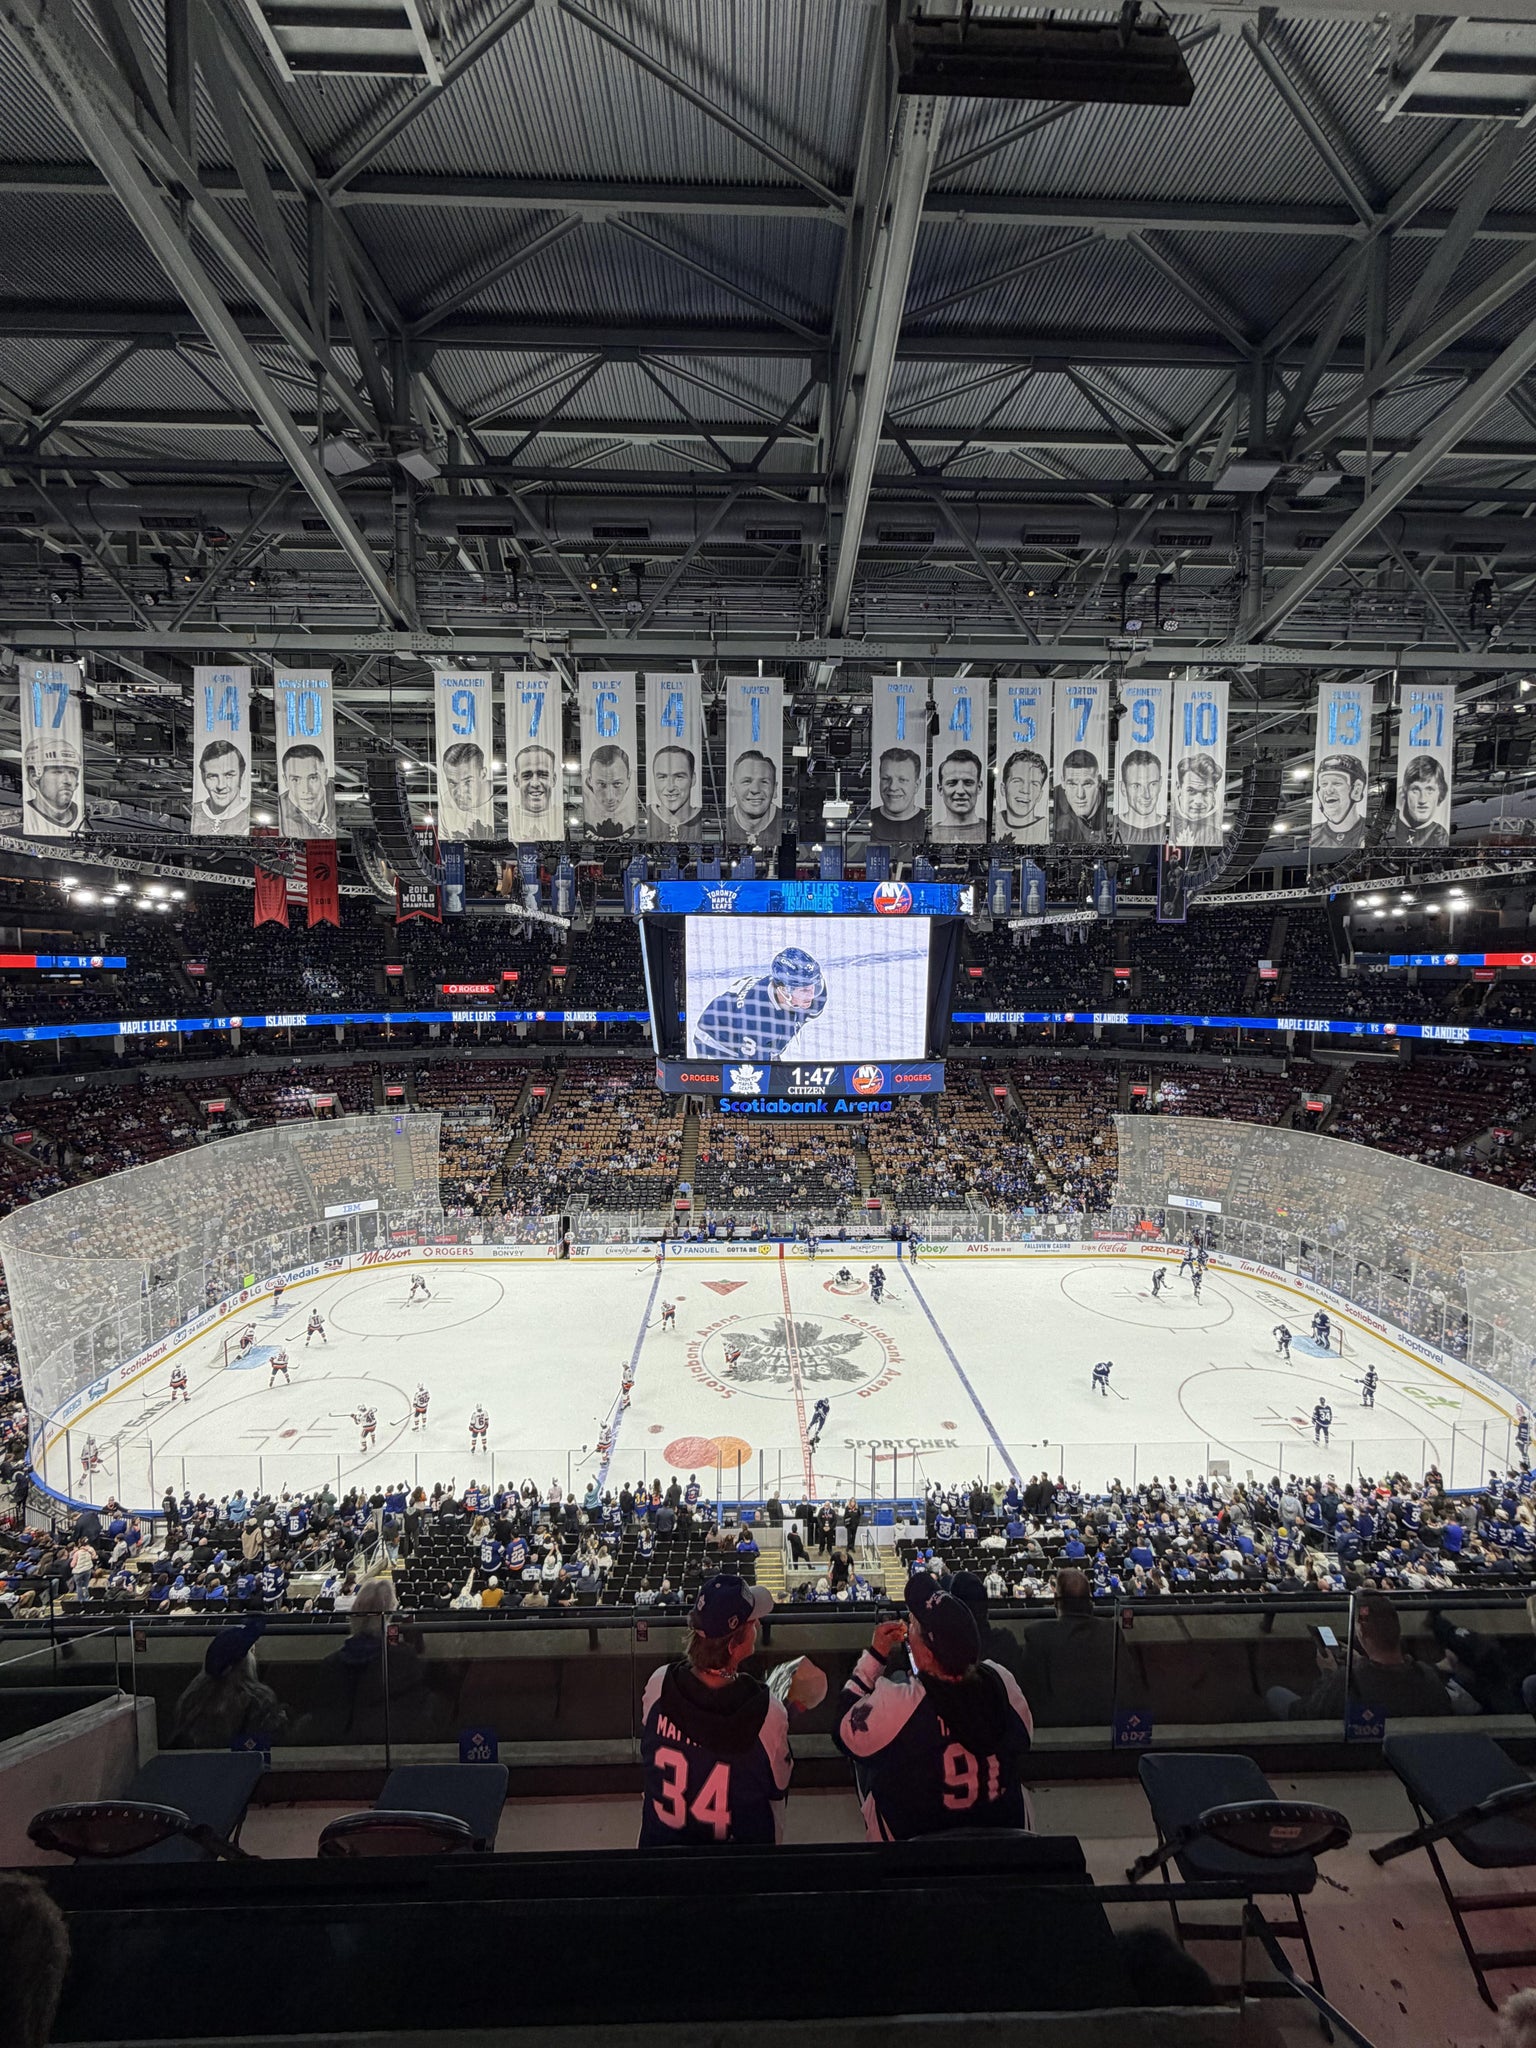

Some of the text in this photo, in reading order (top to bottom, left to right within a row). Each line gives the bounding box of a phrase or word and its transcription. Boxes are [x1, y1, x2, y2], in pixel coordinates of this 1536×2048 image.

[516, 681, 549, 689] CLANCY
[592, 681, 622, 690] BAILEY
[32, 682, 69, 728] 17
[203, 686, 241, 732] 14
[451, 690, 475, 735] 9
[285, 691, 322, 737] 10
[522, 692, 545, 737] 7
[596, 692, 620, 737] 6
[661, 692, 684, 737] 4
[750, 697, 760, 742] 1
[896, 696, 906, 740] 1
[949, 697, 972, 741] 4
[1013, 698, 1036, 742] 5
[1070, 698, 1093, 742] 7
[1132, 699, 1155, 743] 9
[1184, 702, 1218, 746] 10
[1328, 702, 1362, 745] 13
[1409, 703, 1444, 747] 21
[409, 886, 428, 894] 2019
[707, 889, 738, 900] TORONTO
[782, 883, 839, 897] MAPLE LEAFS
[402, 894, 435, 903] WORLD
[79, 957, 87, 966] VS
[1431, 955, 1439, 964] VS
[1368, 964, 1388, 973] 301
[459, 985, 490, 993] ROGERS
[452, 1011, 473, 1022] MAPLE
[475, 1011, 496, 1022] LEAFS
[563, 1011, 597, 1022] ISLANDERS
[985, 1012, 1004, 1022] MAPLE
[1006, 1013, 1025, 1022] LEAFS
[1093, 1013, 1128, 1024] ISLANDERS
[120, 1015, 307, 1034] MAPLE LEAFS VS ISLANDERS
[1277, 1019, 1469, 1040] MAPLE LEAFS VS ISLANDERS
[690, 1074, 720, 1083] ROGERS
[791, 1067, 834, 1085] 1:47
[858, 1066, 878, 1078] NY
[903, 1074, 932, 1083] ROGERS
[788, 1086, 826, 1095] CITIZEN
[719, 1097, 893, 1114] Scotiabank Arena
[343, 1204, 361, 1213] IBM
[1185, 1199, 1204, 1208] IBM
[435, 1247, 474, 1256] ROGERS
[547, 1246, 591, 1256] PSBET
[684, 1246, 719, 1254] FANDUEL
[966, 1244, 989, 1253] AVIS
[1141, 1245, 1186, 1256] pizza pizz
[324, 1258, 343, 1266] SN
[357, 1248, 411, 1266] Molson
[284, 1266, 320, 1283] Medals
[1240, 1260, 1287, 1283] Tim Hortons
[250, 1287, 262, 1298] LG
[1305, 1284, 1314, 1293] AIR
[1314, 1288, 1340, 1304] CANADA
[228, 1298, 239, 1311] LG
[698, 1314, 741, 1338] Arena
[1344, 1303, 1388, 1334] Scotiabank
[841, 1313, 904, 1364] Scotiabank
[745, 1343, 842, 1357] TORONTO
[1398, 1333, 1444, 1364] shoptravel
[120, 1343, 167, 1380] Scotiabank
[760, 1357, 829, 1367] MAPLE
[684, 1340, 737, 1400] Scotiabank
[762, 1366, 832, 1377] LEAFS
[857, 1368, 902, 1398] Arena
[123, 1401, 171, 1427] Eats
[1319, 1410, 1331, 1421] 34
[844, 1438, 959, 1449] SPORTCHEK
[634, 1497, 647, 1510] 34
[511, 1549, 525, 1561] 22
[652, 1745, 731, 1841] 34
